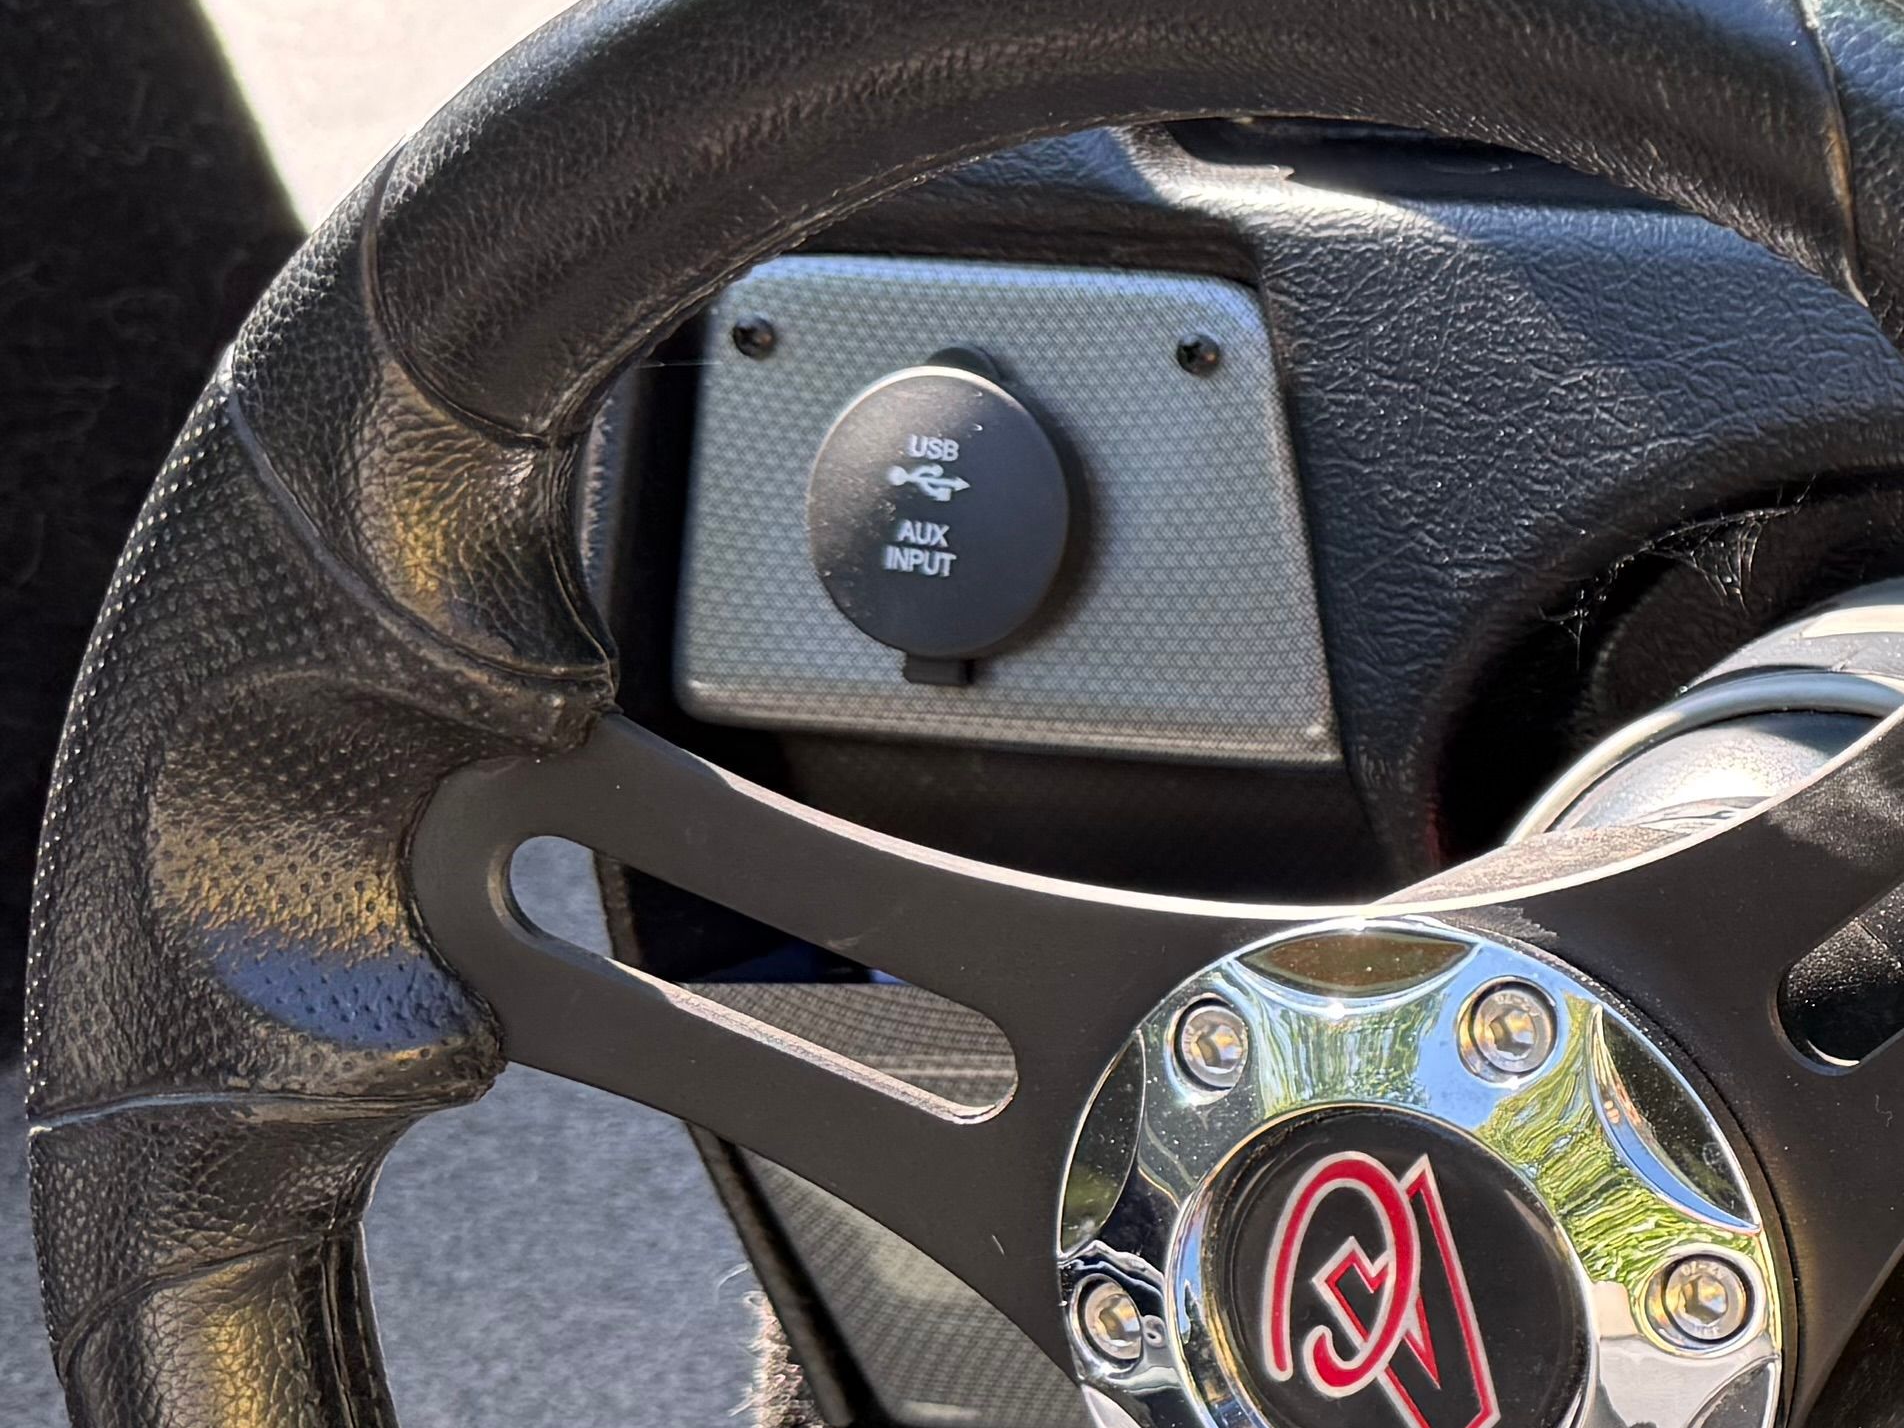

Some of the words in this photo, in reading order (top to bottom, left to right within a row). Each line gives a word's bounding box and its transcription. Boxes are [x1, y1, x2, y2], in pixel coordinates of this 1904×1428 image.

[909, 434, 960, 462] USB
[897, 519, 949, 548] AUX
[884, 545, 957, 577] INPUT
